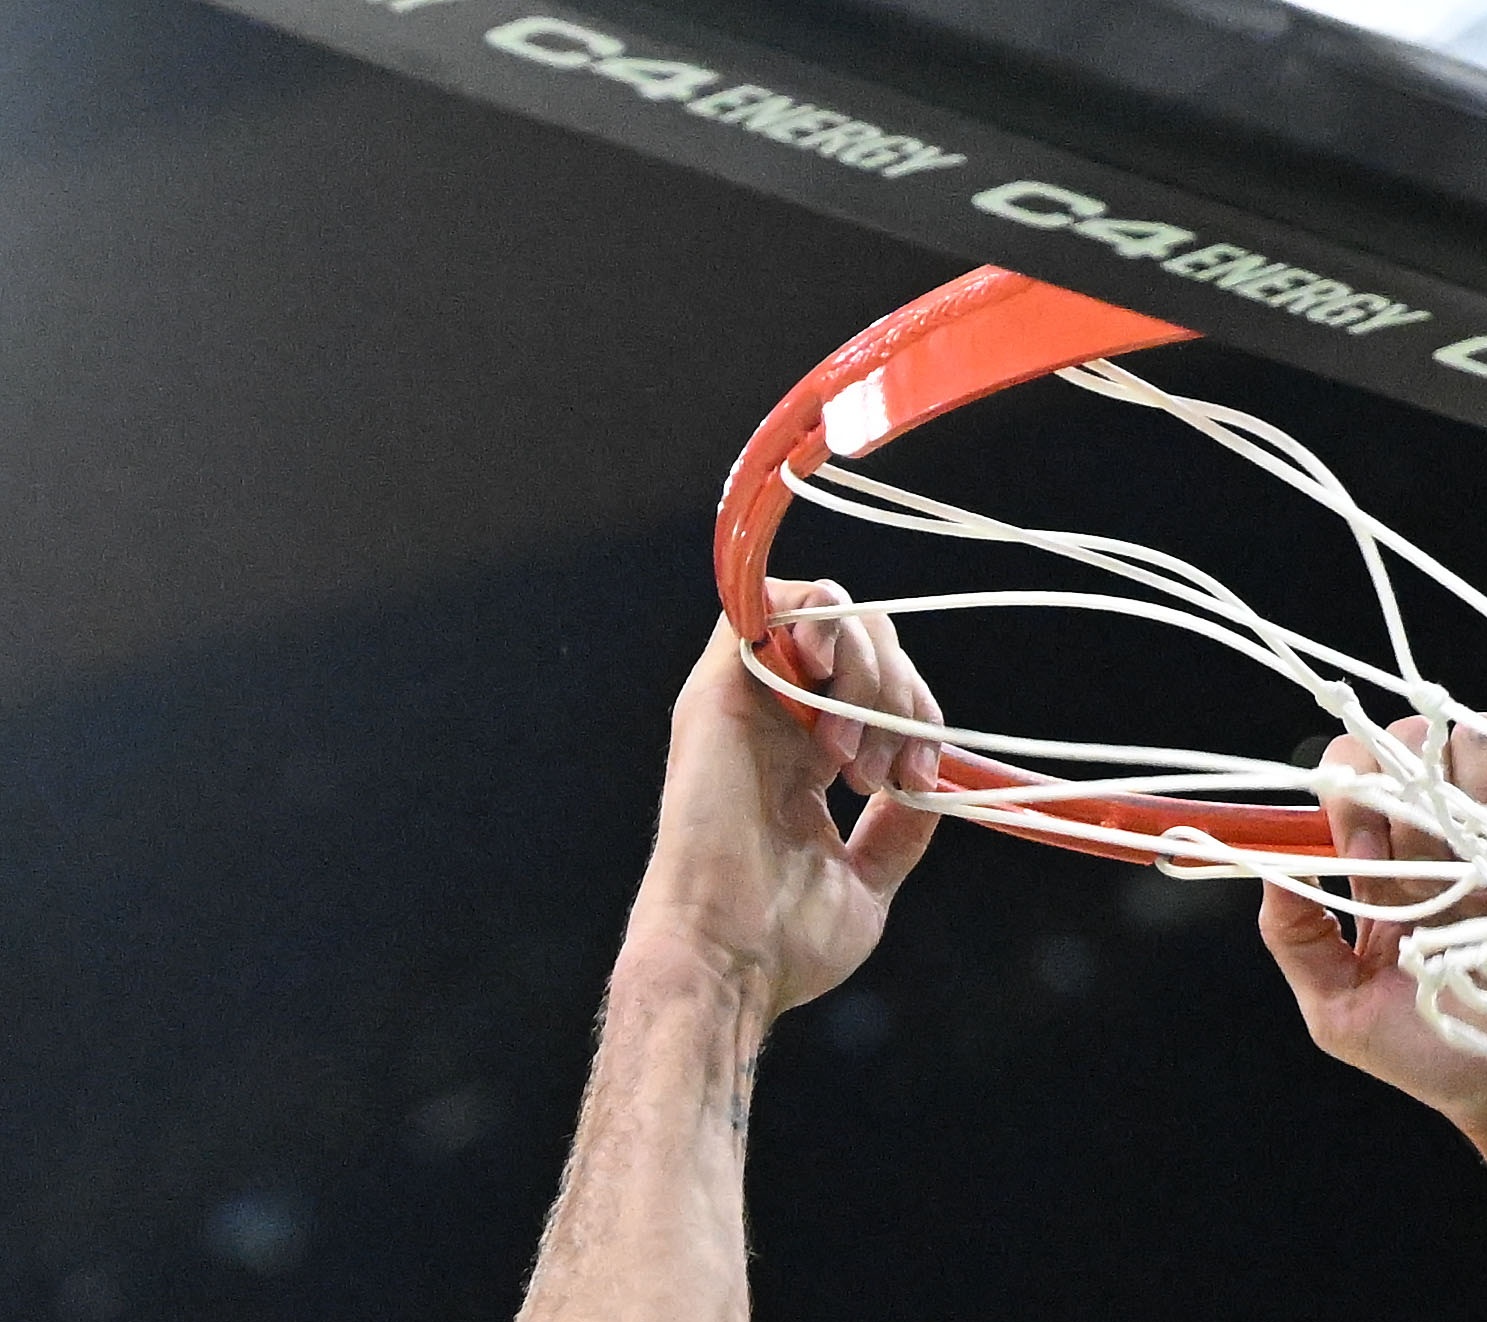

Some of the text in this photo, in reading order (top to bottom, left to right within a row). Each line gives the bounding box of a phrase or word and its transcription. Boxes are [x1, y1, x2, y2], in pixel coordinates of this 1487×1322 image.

[485, 16, 720, 100] C4
[686, 84, 967, 178] ENERGY
[971, 180, 1196, 258] C4
[1160, 243, 1433, 335] ENERGY
